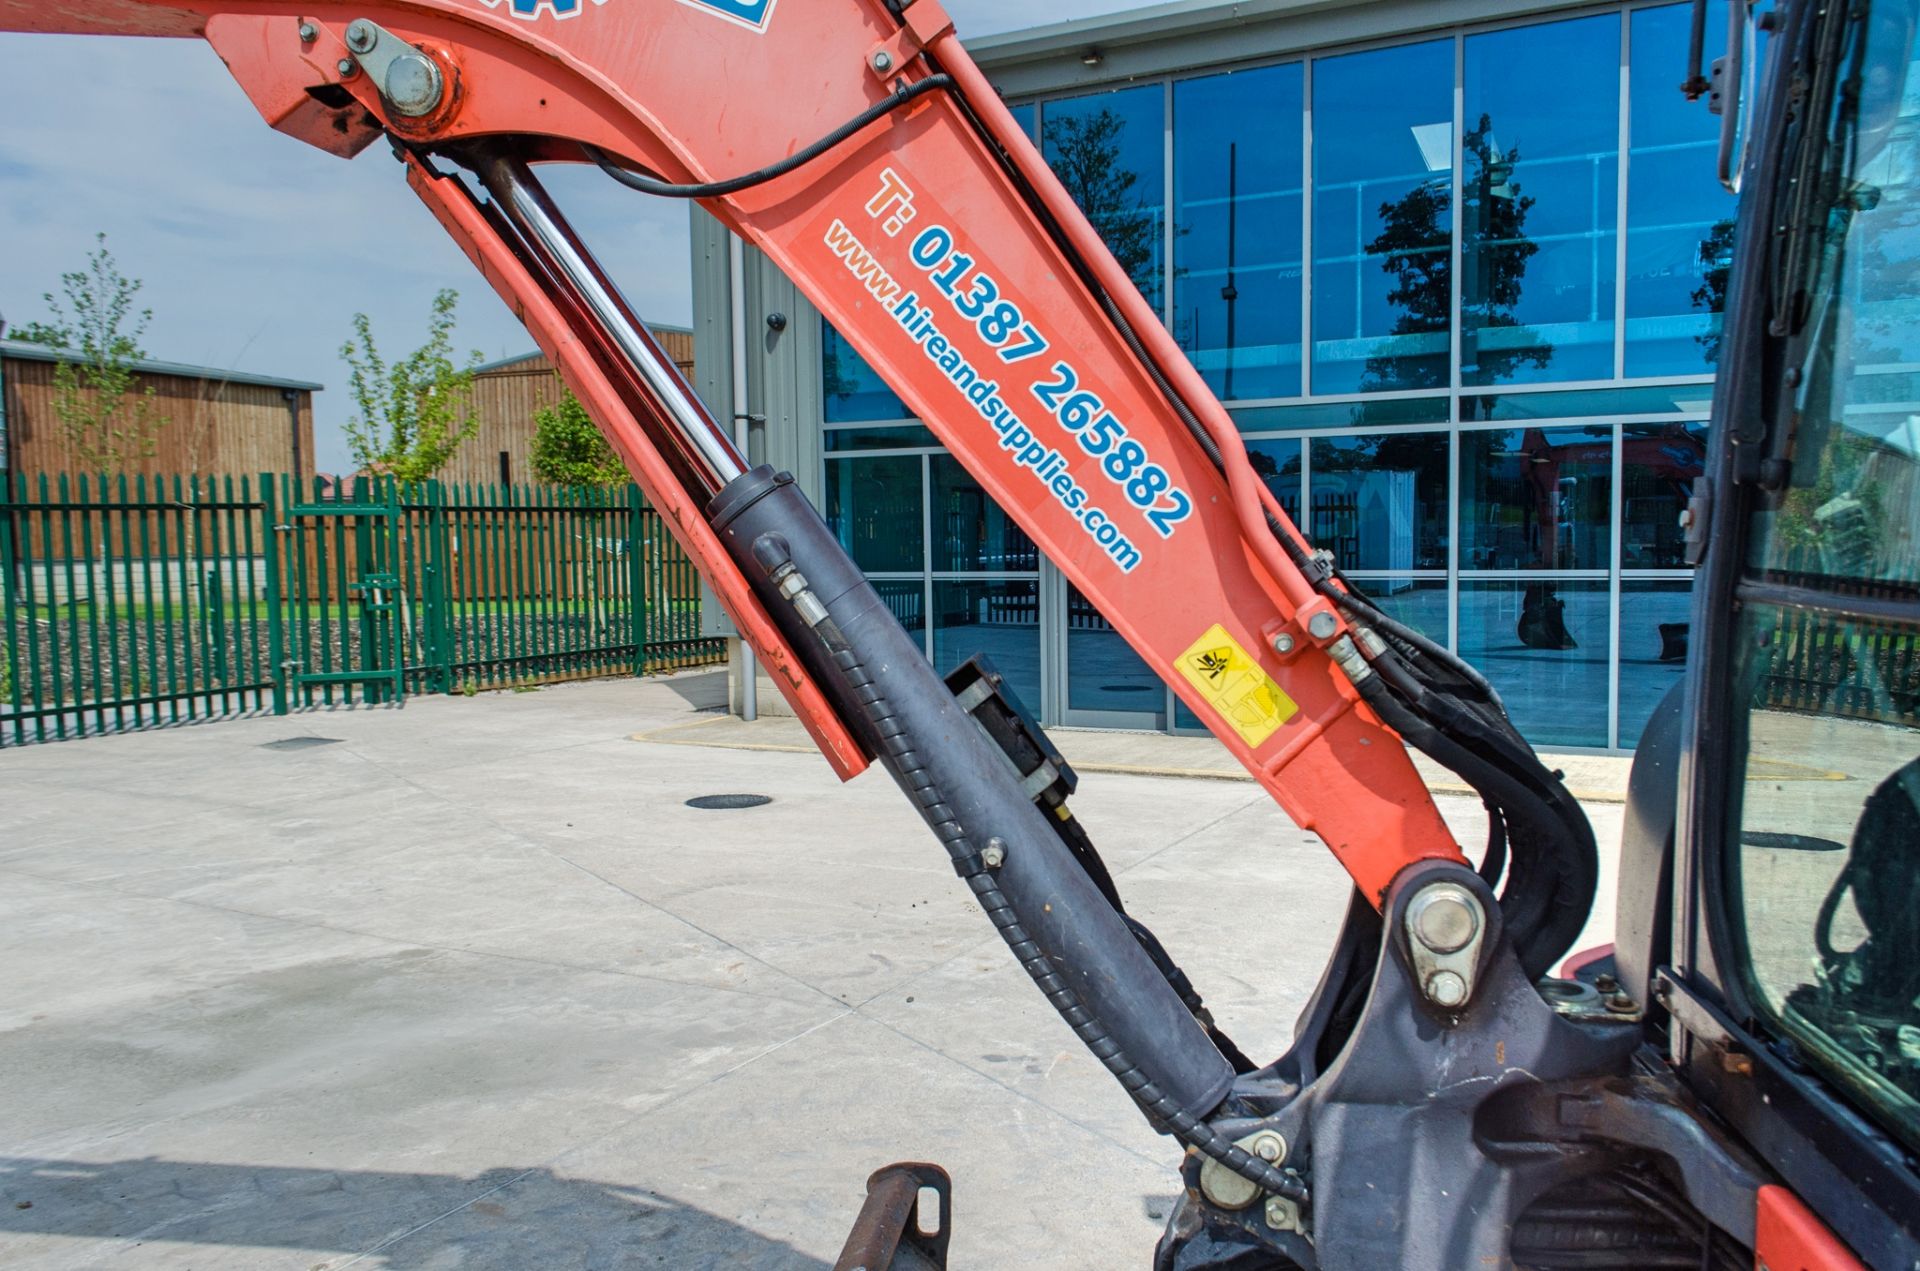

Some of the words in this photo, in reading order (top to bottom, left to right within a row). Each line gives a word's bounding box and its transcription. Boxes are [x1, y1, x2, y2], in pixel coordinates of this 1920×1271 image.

[824, 219, 1142, 574] www.hireandsupplies.com
[865, 168, 917, 237] T:
[910, 225, 1048, 364] 01387
[1030, 360, 1194, 540] 265882
